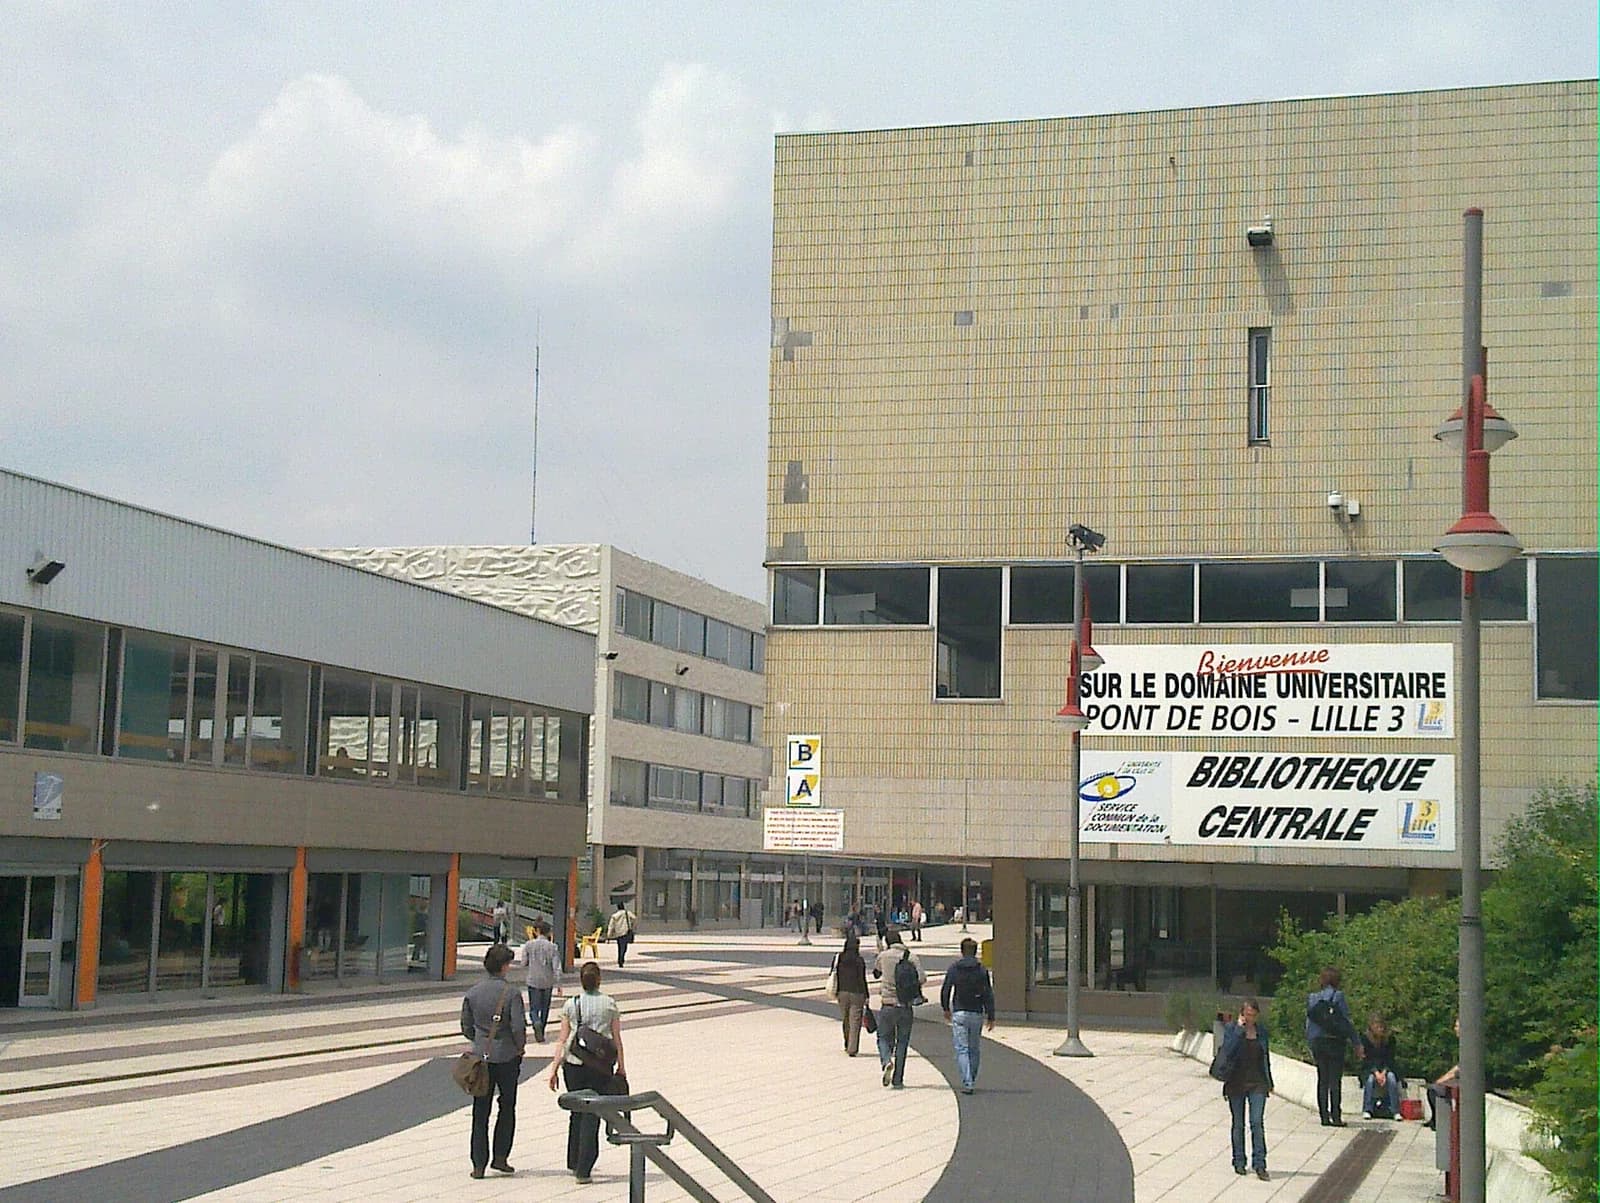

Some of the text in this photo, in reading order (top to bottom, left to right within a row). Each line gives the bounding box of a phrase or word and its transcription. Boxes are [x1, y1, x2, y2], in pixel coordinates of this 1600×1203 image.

[1198, 648, 1330, 677] Bienvenue
[1080, 672, 1446, 698] SUR LE DOMAINE UNIVERSITAIRE
[1085, 704, 1160, 731] PONT
[1167, 705, 1203, 731] DE
[1212, 705, 1276, 731] BOIS
[1311, 705, 1379, 731] LILLE
[1387, 705, 1405, 731] 3
[798, 744, 813, 761] B
[1187, 756, 1436, 793] BIBLIOTHEQUE
[796, 779, 812, 796] A
[1098, 803, 1138, 812] SERVICE
[1421, 801, 1432, 816] 3
[1091, 813, 1137, 822] COMMUN
[1198, 805, 1379, 841] CENTRALE
[1084, 823, 1167, 833] DOCUMENTATION
